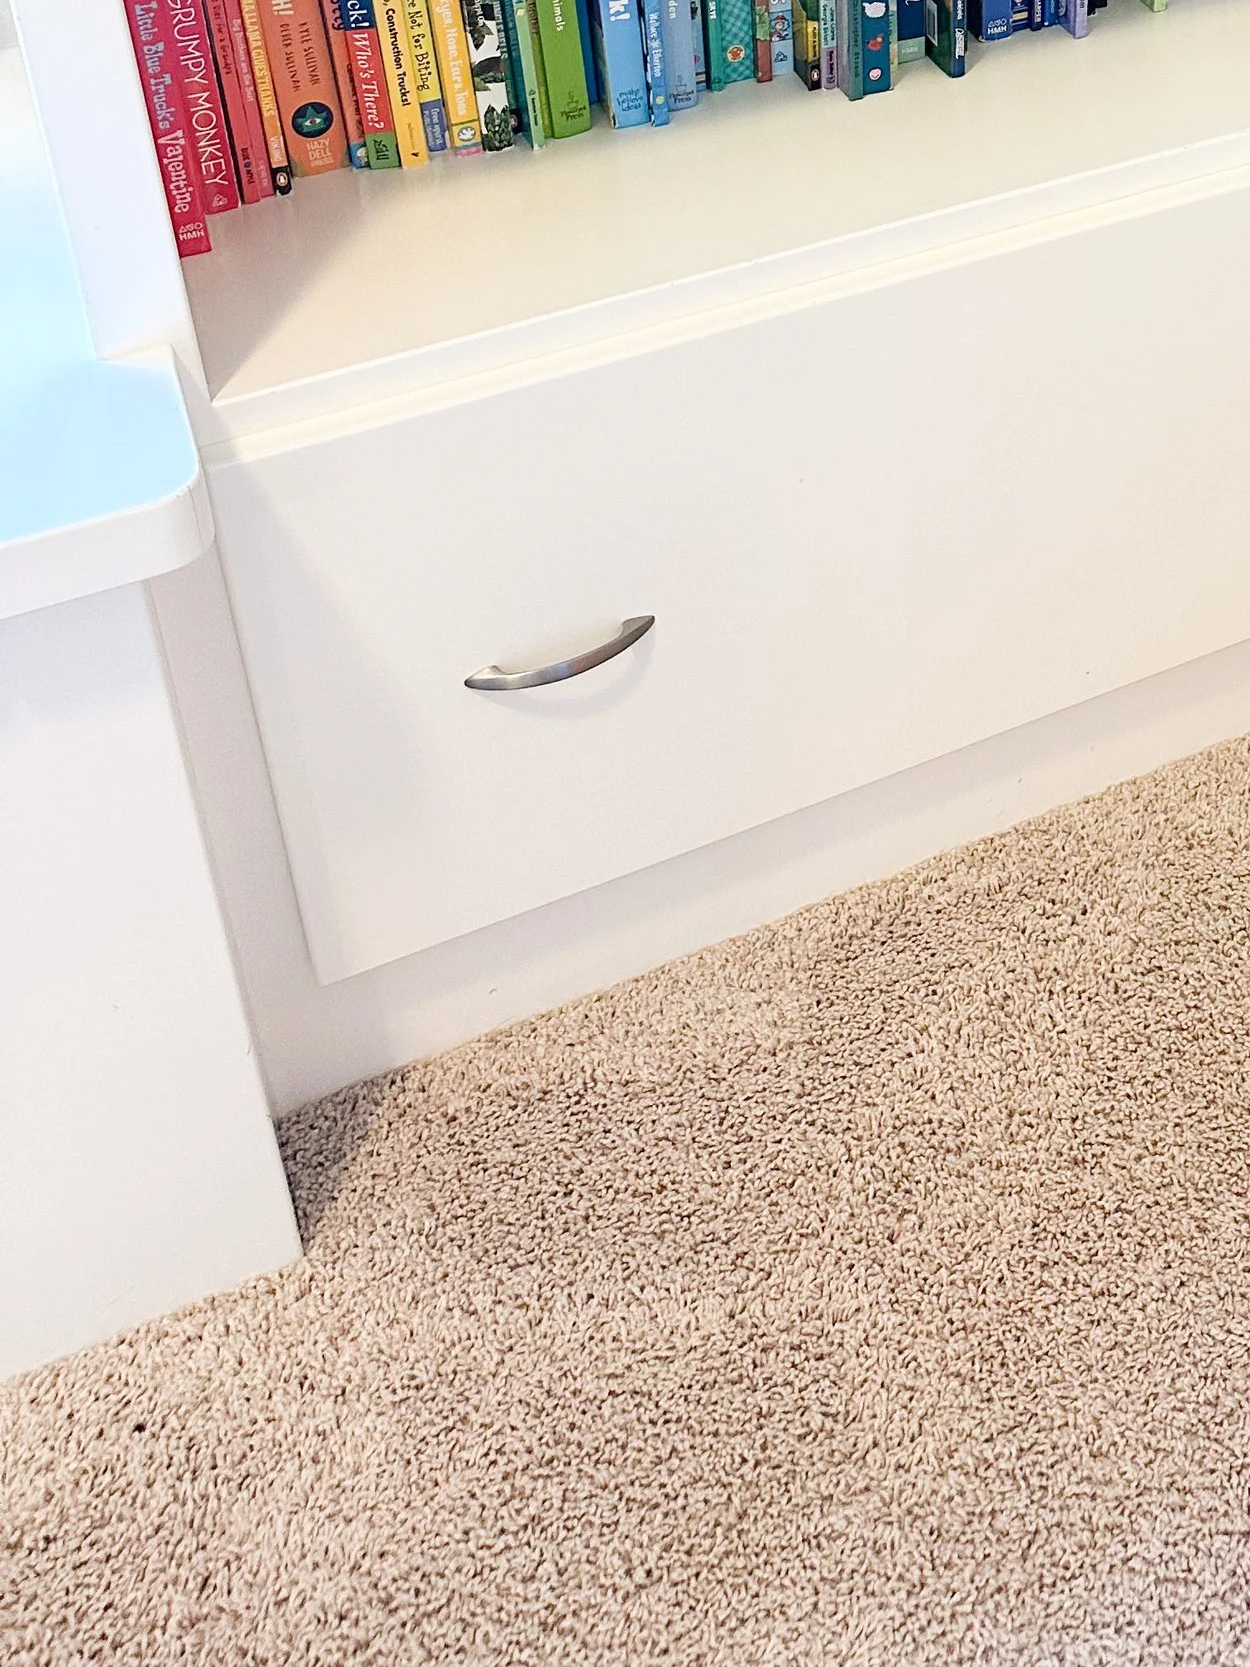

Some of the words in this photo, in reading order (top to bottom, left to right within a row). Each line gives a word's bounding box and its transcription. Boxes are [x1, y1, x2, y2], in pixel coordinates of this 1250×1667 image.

[133, 0, 158, 41] Little
[143, 41, 165, 74] Blue
[352, 32, 374, 79] Who's
[385, 8, 403, 71] Construction
[396, 72, 411, 107] Trucks!
[150, 74, 175, 130] Truck's
[361, 81, 385, 129] There?
[188, 91, 229, 186] MONKEY
[158, 130, 194, 214] Valentine
